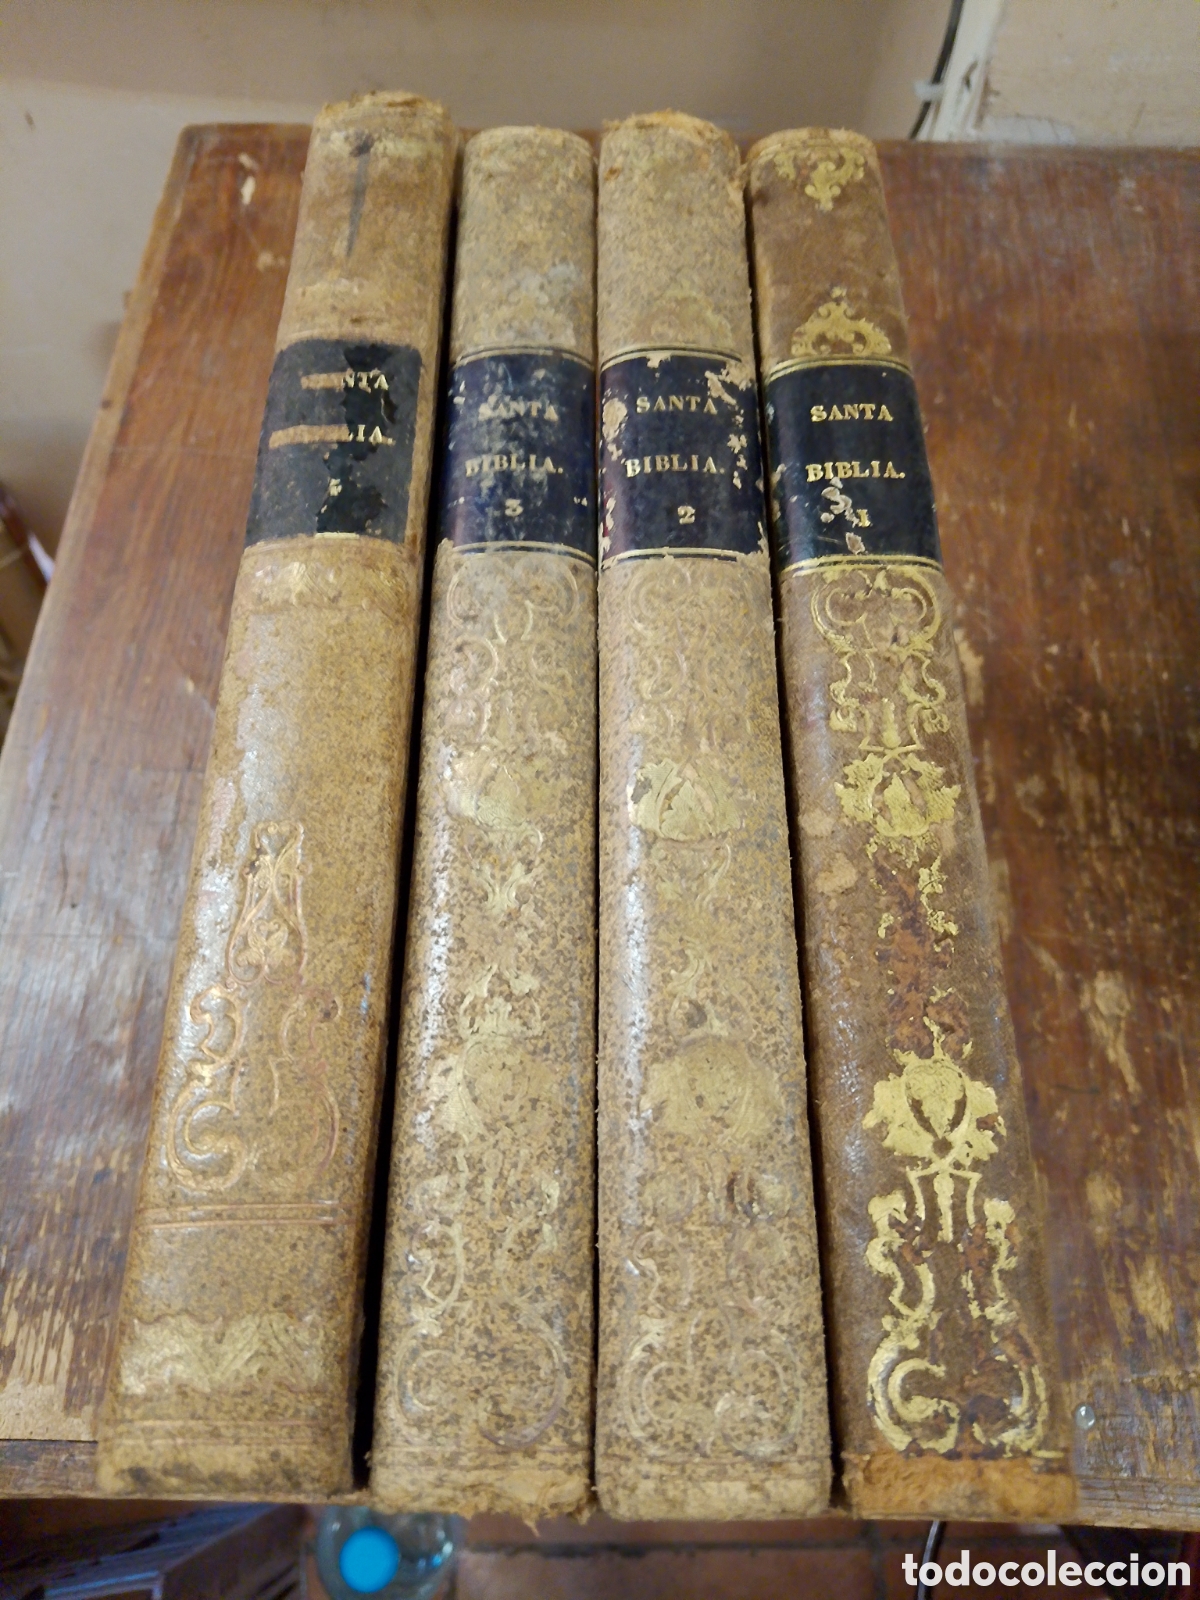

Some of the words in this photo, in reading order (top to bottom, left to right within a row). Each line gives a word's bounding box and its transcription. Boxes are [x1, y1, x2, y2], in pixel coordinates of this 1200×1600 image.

[636, 395, 718, 416] SANTA
[810, 404, 894, 422] SANTA
[625, 454, 725, 477] BIBLIA.
[806, 460, 905, 482] BIBLIA.
[677, 506, 695, 525] 2
